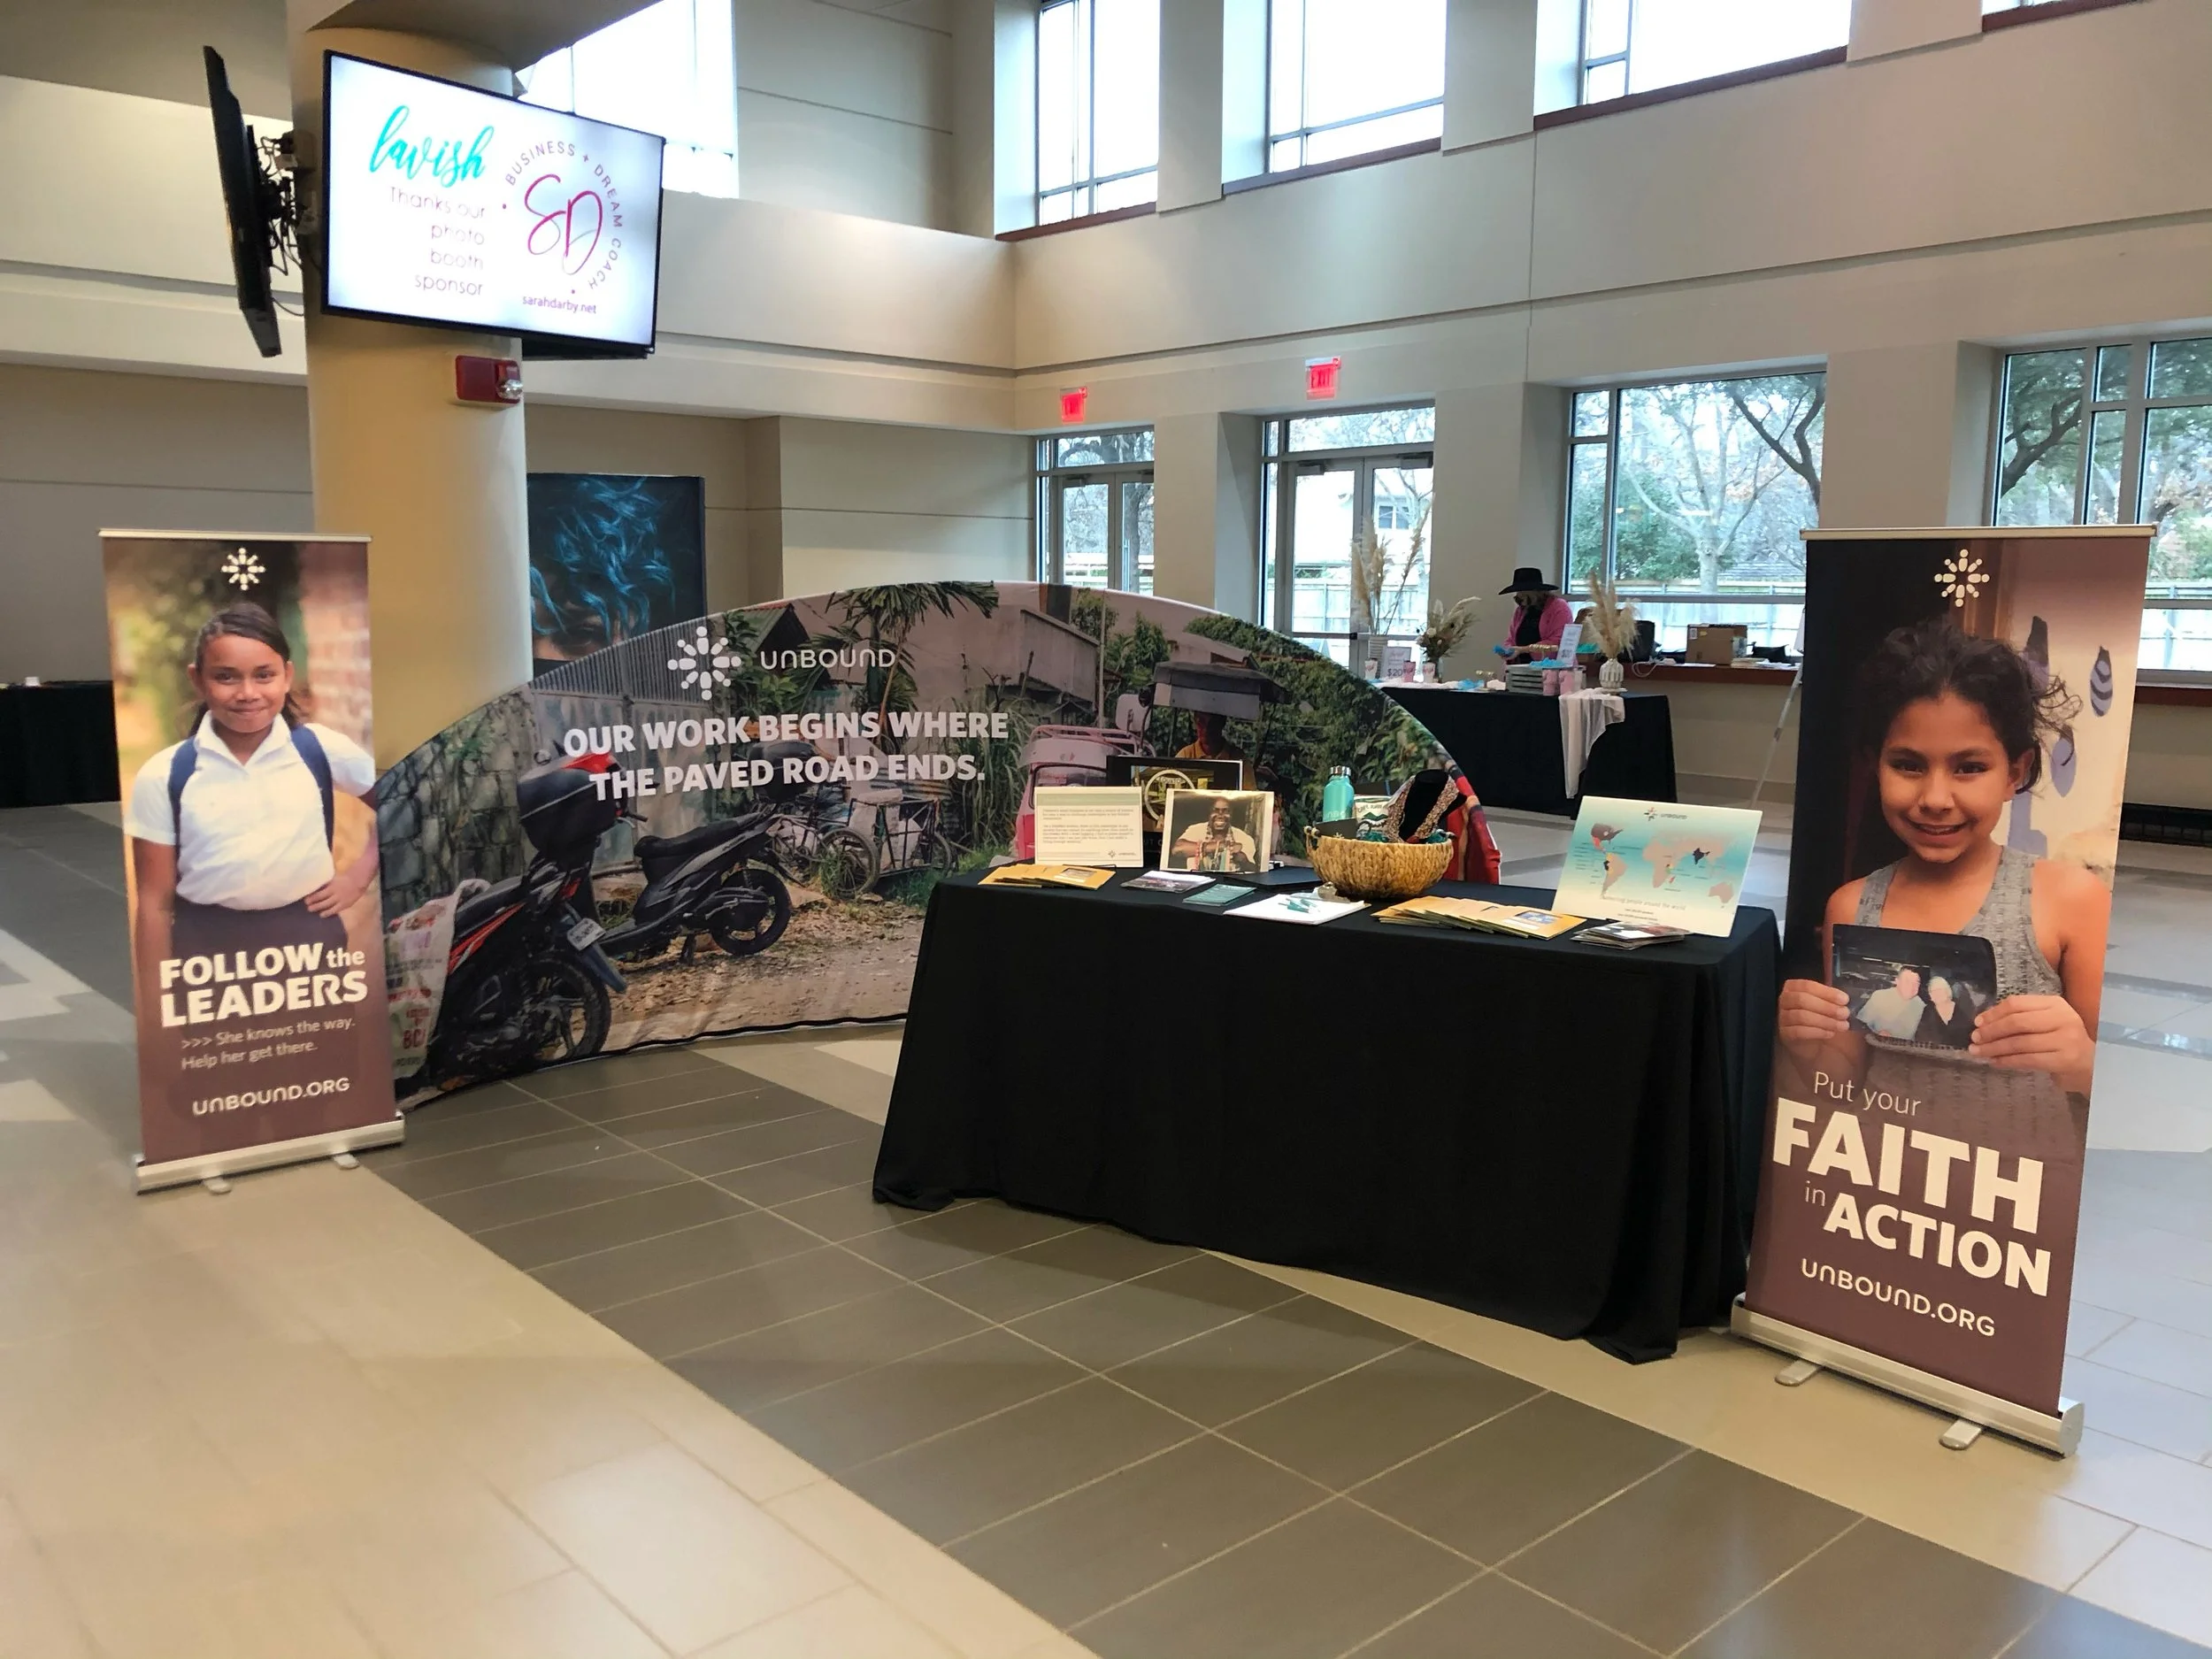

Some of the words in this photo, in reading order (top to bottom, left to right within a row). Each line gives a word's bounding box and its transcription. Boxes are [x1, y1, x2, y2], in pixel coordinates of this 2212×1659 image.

[369, 105, 495, 188] lavish
[505, 141, 575, 186] BUSINESS
[390, 186, 451, 214] Thanks
[457, 204, 485, 219] our
[594, 164, 623, 228] DREAM
[431, 224, 485, 245] photo
[431, 248, 484, 271] booth
[588, 237, 622, 289] COACH
[415, 274, 482, 296] sponsor
[522, 296, 596, 314] sarahdarby.net
[563, 724, 637, 757] OUR
[641, 716, 752, 751] WORK
[758, 711, 880, 741] BEGINS
[887, 711, 1009, 740] WHERE
[589, 771, 657, 802] THE
[665, 758, 774, 794] PAVED
[783, 754, 879, 785] ROAD
[888, 754, 986, 781] ENDS.
[159, 942, 323, 990] FOLLOW
[326, 947, 365, 969] the
[160, 970, 368, 1028] LEADERS
[215, 1031, 244, 1046] She
[246, 1025, 294, 1041] knows
[296, 1020, 320, 1034] the
[324, 1018, 356, 1031] way.
[181, 1054, 218, 1070] Help
[220, 1050, 247, 1064] her
[249, 1045, 273, 1063] get
[276, 1041, 319, 1056] there.
[1814, 1071, 1855, 1102] Put
[1863, 1088, 1922, 1117] your
[1772, 1096, 2044, 1234] FAITH
[1805, 1180, 1826, 1207] in
[1823, 1192, 2051, 1297] ACTION
